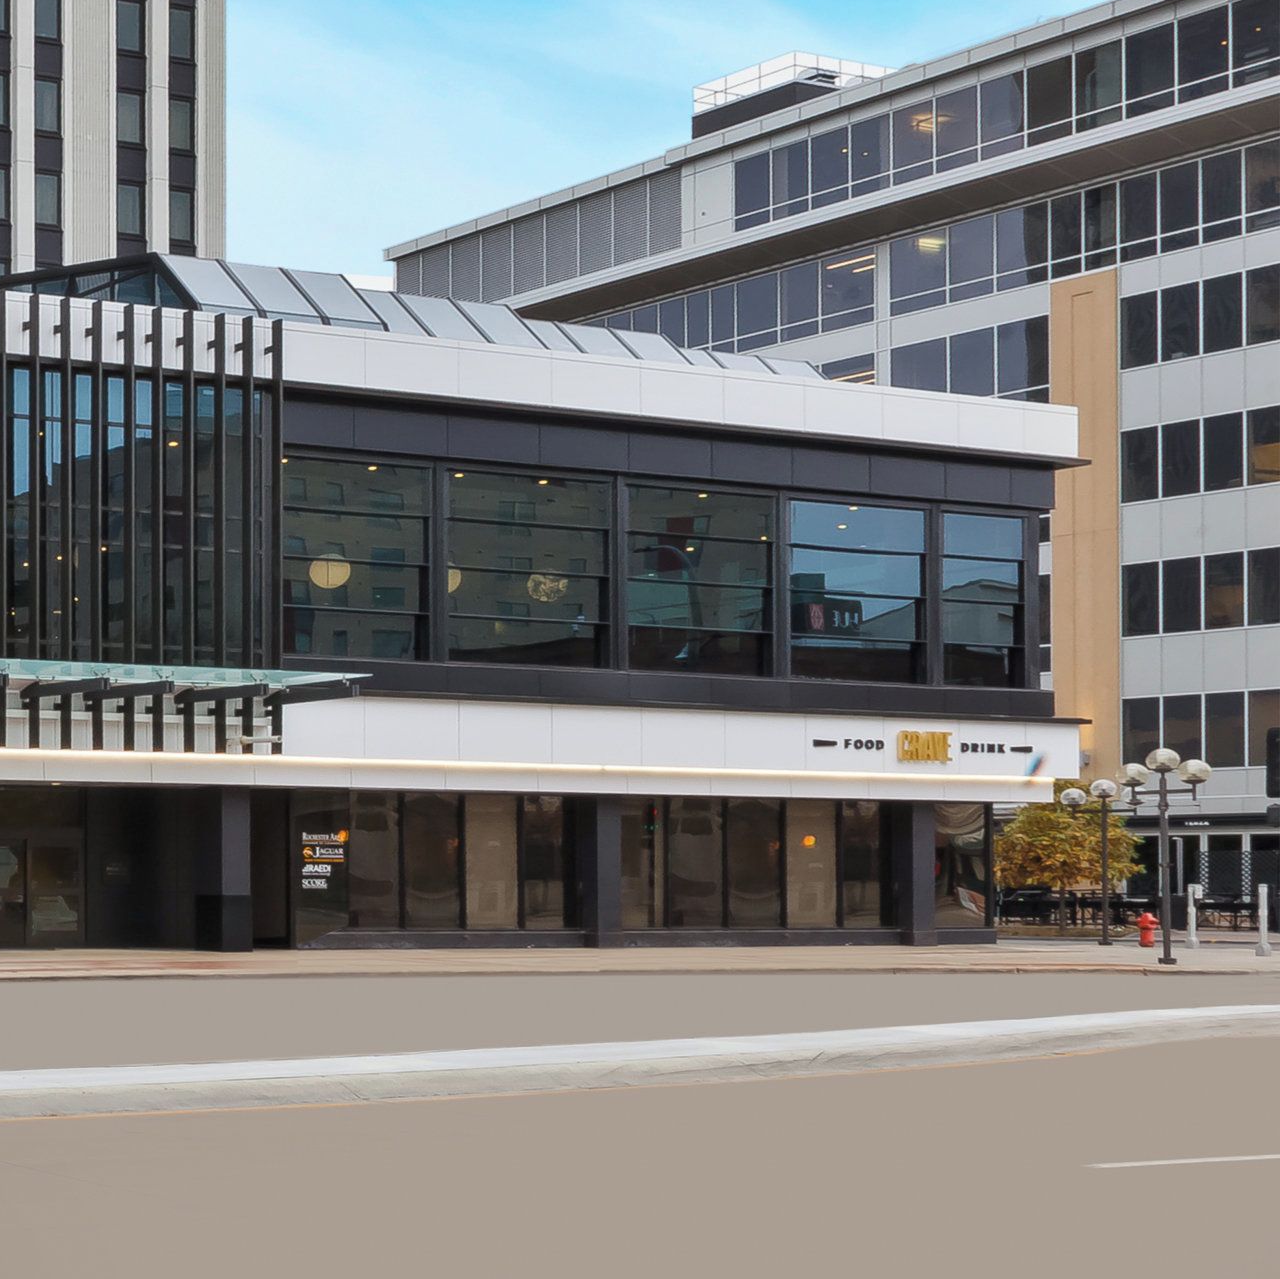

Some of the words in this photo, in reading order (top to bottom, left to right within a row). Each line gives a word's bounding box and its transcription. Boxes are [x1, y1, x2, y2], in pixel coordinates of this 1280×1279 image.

[844, 738, 885, 750] FOOD
[897, 730, 953, 762] CRAVE
[960, 742, 1006, 754] DRINK
